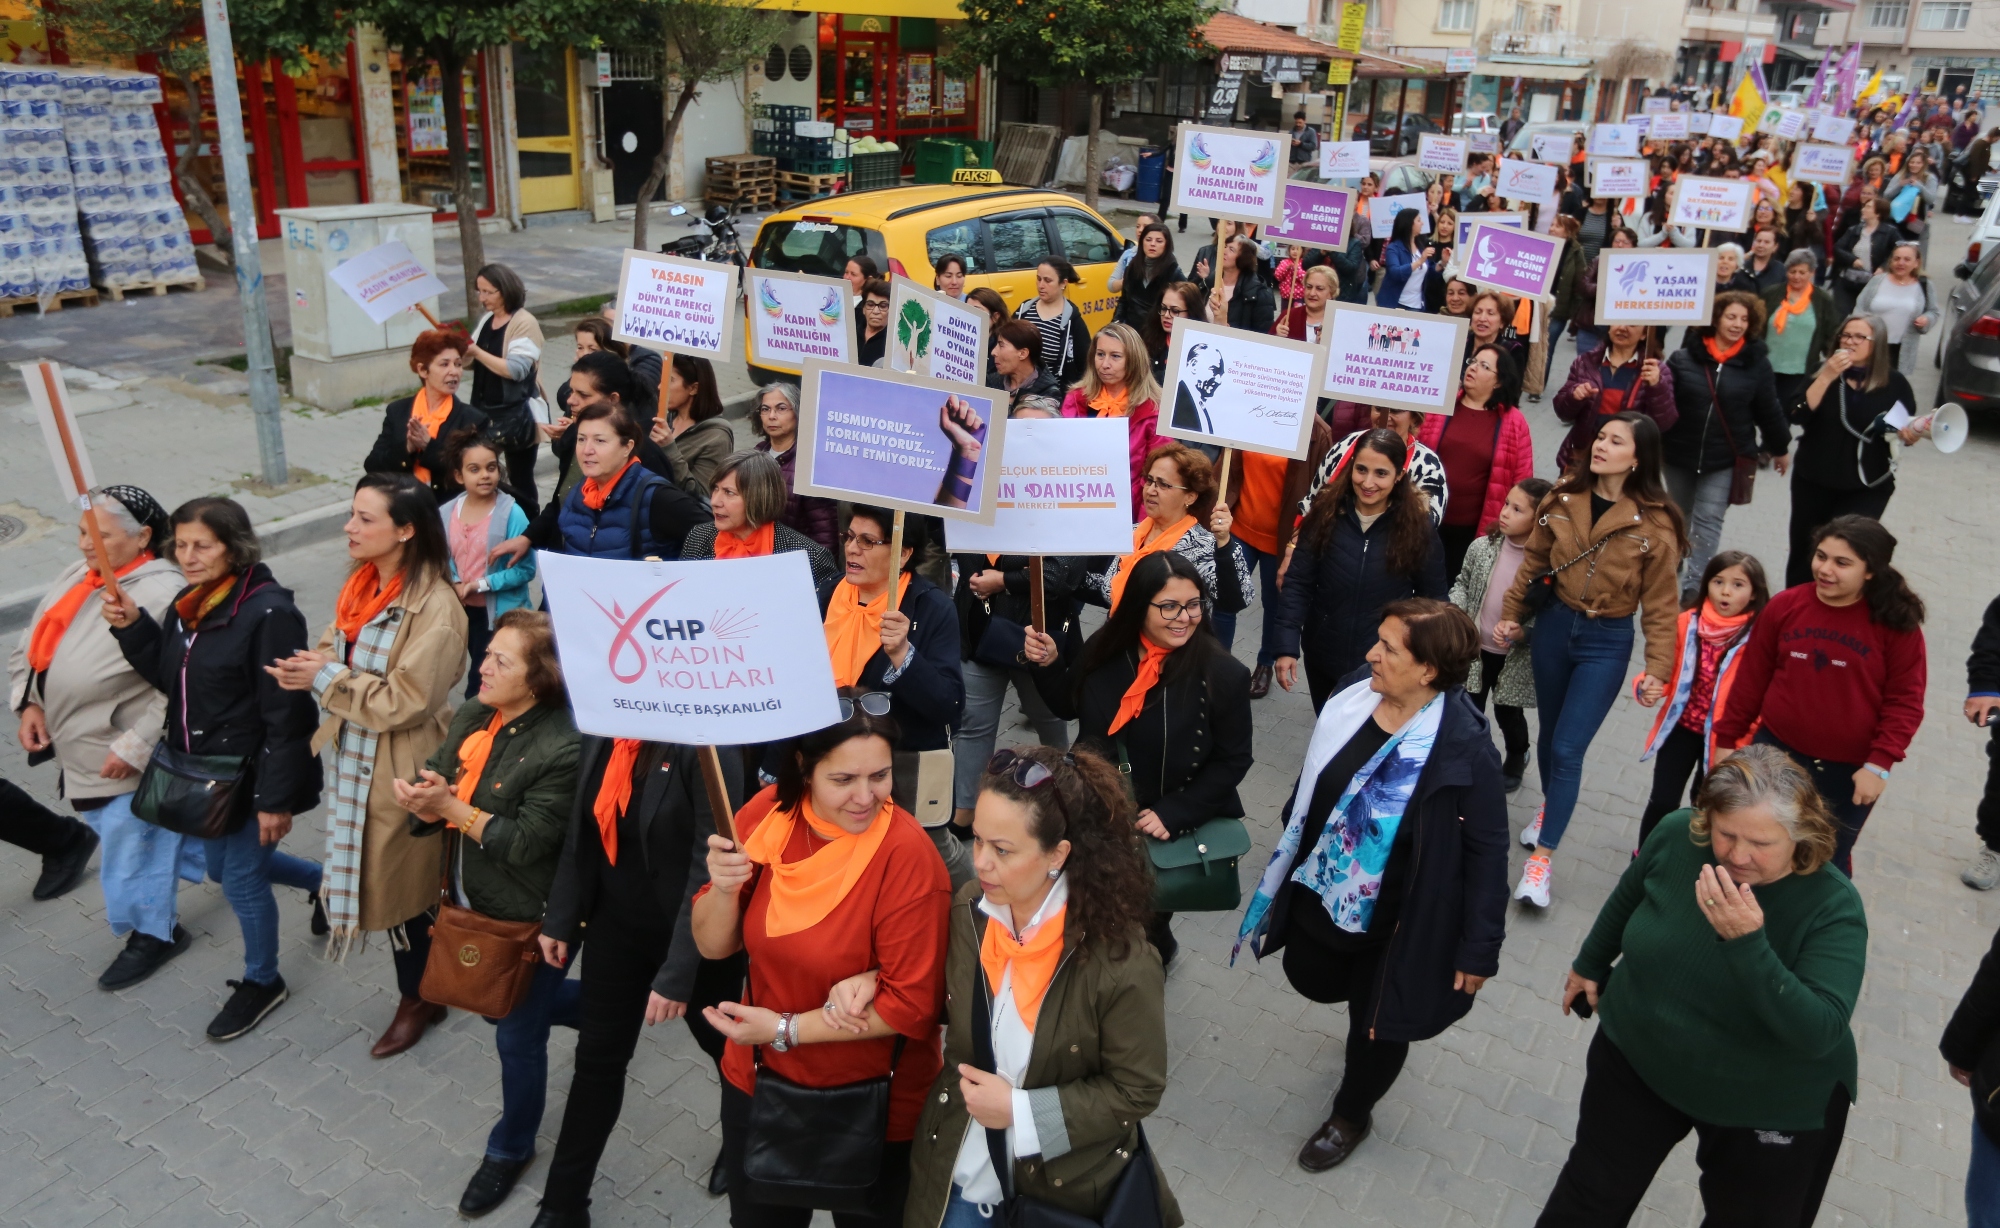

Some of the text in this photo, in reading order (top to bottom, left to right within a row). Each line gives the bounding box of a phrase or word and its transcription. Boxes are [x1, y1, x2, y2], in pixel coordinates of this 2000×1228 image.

[1211, 165, 1245, 177] KADIN
[1196, 176, 1258, 192] İNSANLIĞIN
[1188, 187, 1264, 206] KANATLARIDIR
[1300, 212, 1340, 224] EMEĞİNE
[1312, 204, 1341, 215] KADIN
[1310, 223, 1338, 233] SAYGI
[1504, 257, 1544, 274] EMEĞİNE
[1517, 251, 1547, 264] KADIN
[651, 268, 704, 287] YAŞASIN
[1514, 269, 1541, 282] SAYGI
[1654, 276, 1698, 286] YAŞAM
[656, 284, 695, 297] 8 MART
[1657, 289, 1696, 297] HAKKI
[638, 292, 712, 314] DÜNYA EMEKÇİ
[1082, 302, 1091, 314] 35
[1094, 299, 1104, 312] AZ
[1614, 299, 1695, 310] HERKESİNDİR
[632, 303, 715, 325] KADINLAR GÜNÜ
[784, 314, 816, 327] KADIN
[773, 323, 831, 342] İNSANLIĞIN
[949, 316, 977, 335] DÜNYA
[937, 324, 976, 347] YERİNDEN
[767, 338, 839, 357] KANATLARIDIR
[947, 340, 975, 359] OYNAR
[934, 347, 974, 370] KADINLAR
[1345, 353, 1434, 372] HAKLARIMIZ VE
[945, 362, 974, 382] ÖZGÜR
[1346, 365, 1429, 384] HAYATLARIMIZ
[1332, 372, 1439, 396] İÇİN BİR ARADAYIZ
[827, 410, 924, 437] SUSMUYORUZ...
[826, 426, 935, 455] KORKMUYORUZ...
[825, 438, 945, 472] İTAAT ETMİYORUZ...
[1000, 464, 1108, 478] ELÇUK BELEDİYESİ
[1025, 483, 1115, 502] DANIŞMA
[1018, 501, 1056, 509] MERKEZİ
[646, 619, 705, 641] CHP
[651, 645, 745, 664] KADIN
[657, 667, 774, 689] KOLLARI
[613, 698, 782, 717] SELÇUK İLÇE BAŞKANLIĞI
